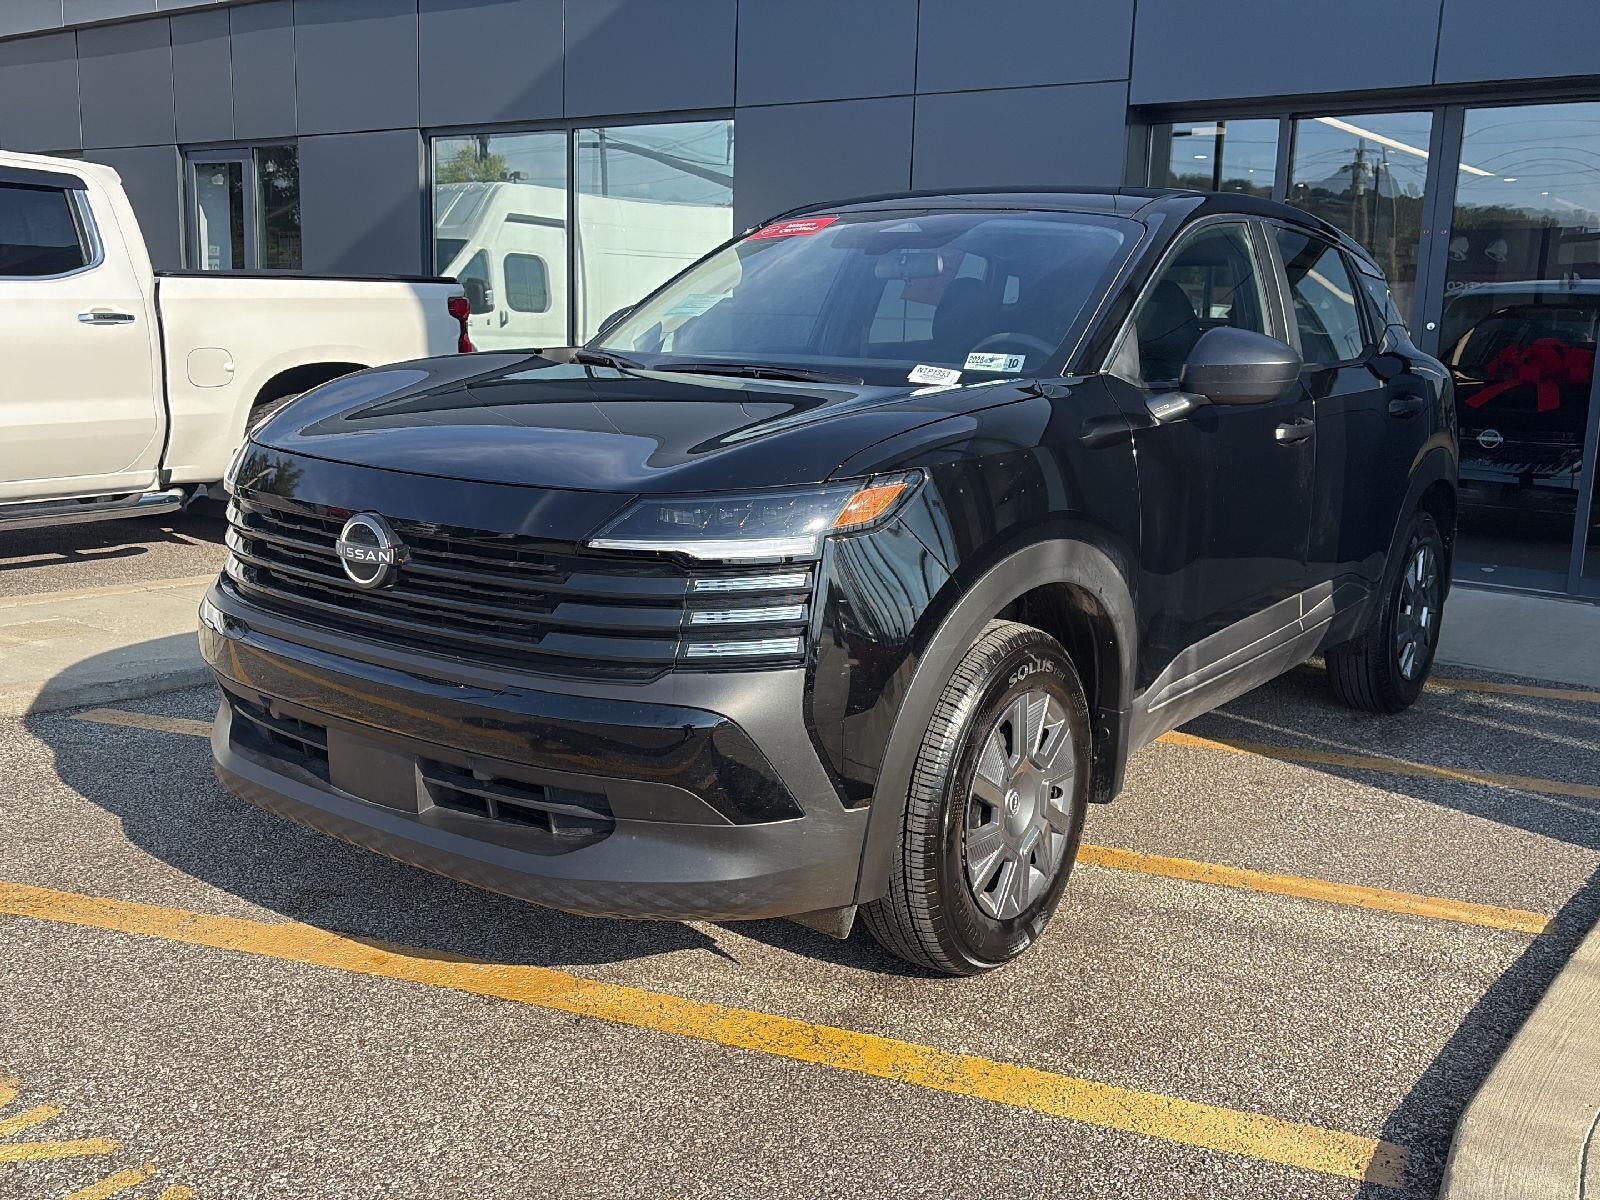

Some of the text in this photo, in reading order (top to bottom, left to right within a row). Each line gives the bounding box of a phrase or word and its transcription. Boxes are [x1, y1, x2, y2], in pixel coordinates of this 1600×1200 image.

[1007, 358, 1019, 368] 10
[336, 543, 390, 563] NISSAN
[1008, 658, 1055, 689] SOLUS
